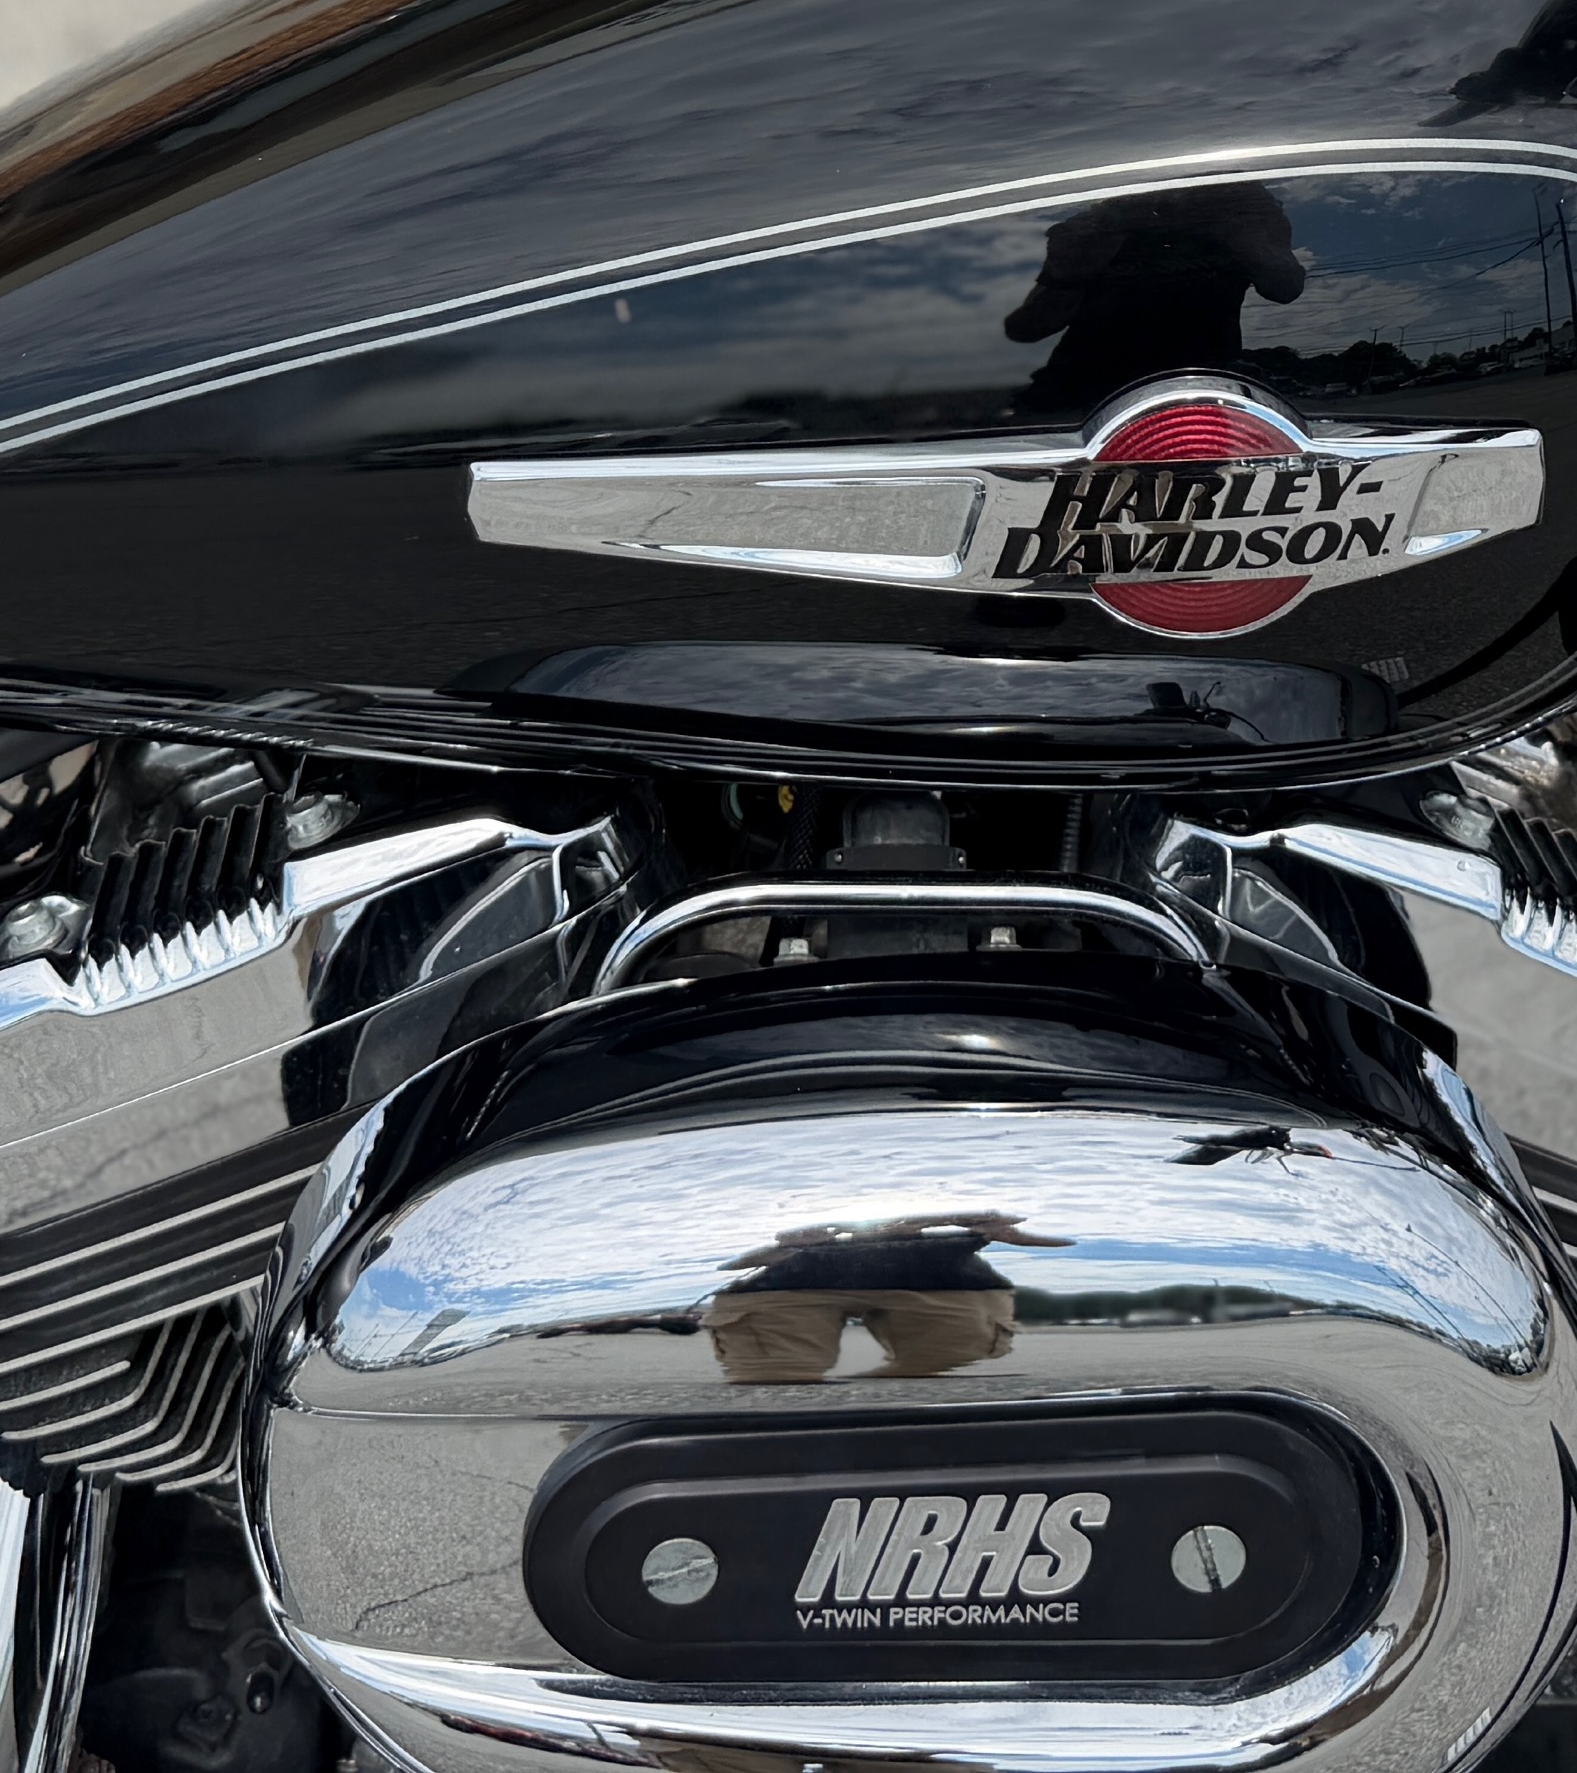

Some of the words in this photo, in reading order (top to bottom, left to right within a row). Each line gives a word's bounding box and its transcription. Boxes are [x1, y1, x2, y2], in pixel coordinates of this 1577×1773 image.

[1040, 461, 1384, 531] HARLEY-
[795, 1492, 1111, 1602] NRHS
[796, 1607, 881, 1629] V-TWIN
[889, 1602, 1080, 1627] PERFORMANCE
